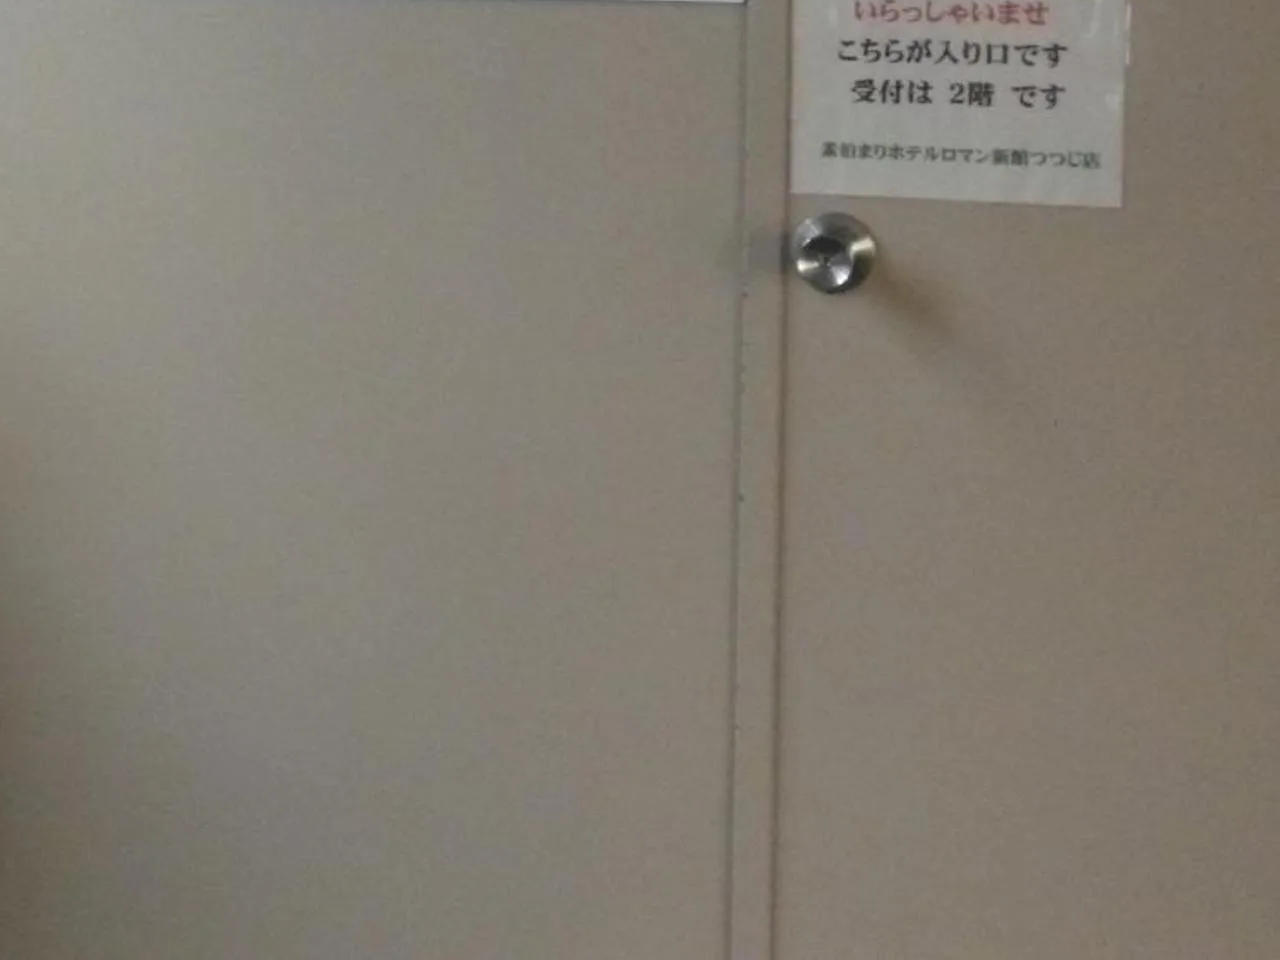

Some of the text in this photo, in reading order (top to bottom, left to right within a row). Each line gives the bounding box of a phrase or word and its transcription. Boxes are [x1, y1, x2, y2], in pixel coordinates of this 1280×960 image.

[854, 0, 1050, 26] いらっしゃいませ
[838, 39, 1069, 68] こちらが入り口です
[851, 79, 1067, 110] 受付は 2階 です
